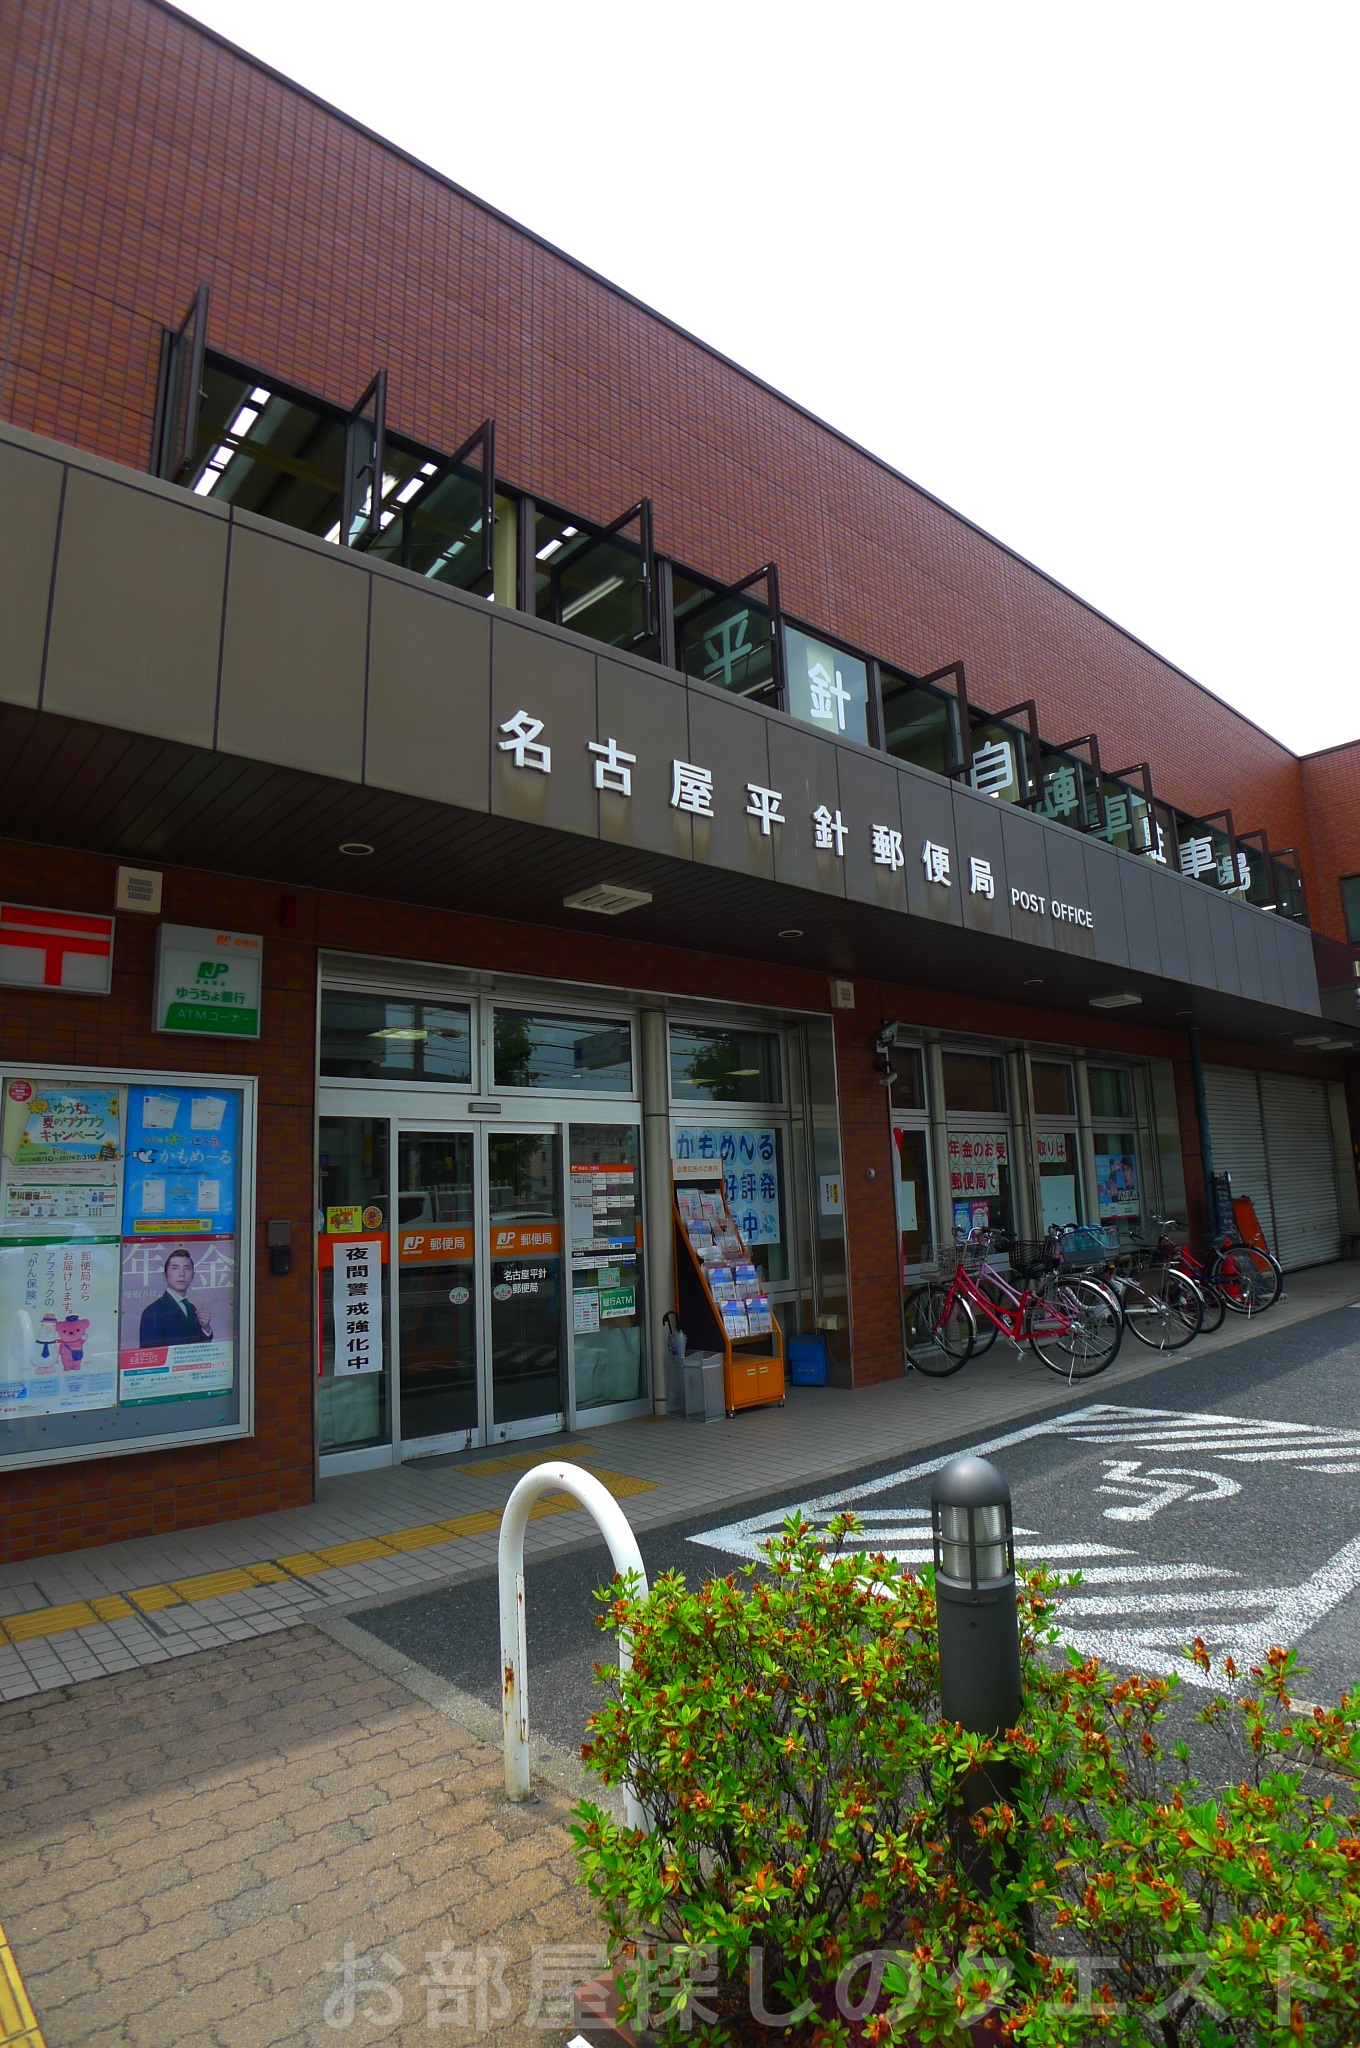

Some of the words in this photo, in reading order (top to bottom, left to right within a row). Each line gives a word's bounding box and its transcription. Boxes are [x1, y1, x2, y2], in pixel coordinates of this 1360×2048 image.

[497, 709, 995, 901] 名古屋平針郵便局
[1010, 887, 1045, 915] POST
[1051, 900, 1095, 929] OFFICE
[176, 987, 246, 1004] ゆうちょ銀行
[177, 1008, 251, 1022] ATMコーナー
[53, 1102, 91, 1114] ゆうちょ
[42, 1115, 104, 1129] 夏のワクワク
[40, 1130, 106, 1142] キャンペーン
[951, 1172, 997, 1190] 郵便局で
[403, 1236, 425, 1250] JP
[430, 1236, 465, 1251] 郵便局
[497, 1232, 516, 1245] JP
[520, 1232, 552, 1246] 郵便局
[44, 1252, 55, 1307] アフラックの
[80, 1251, 91, 1301] 郵便局から
[503, 1267, 547, 1282] 名古屋平針
[512, 1282, 539, 1294] 郵便局
[346, 1247, 369, 1369] 夜間警戒強化中
[602, 1295, 633, 1307] 銀行ATM
